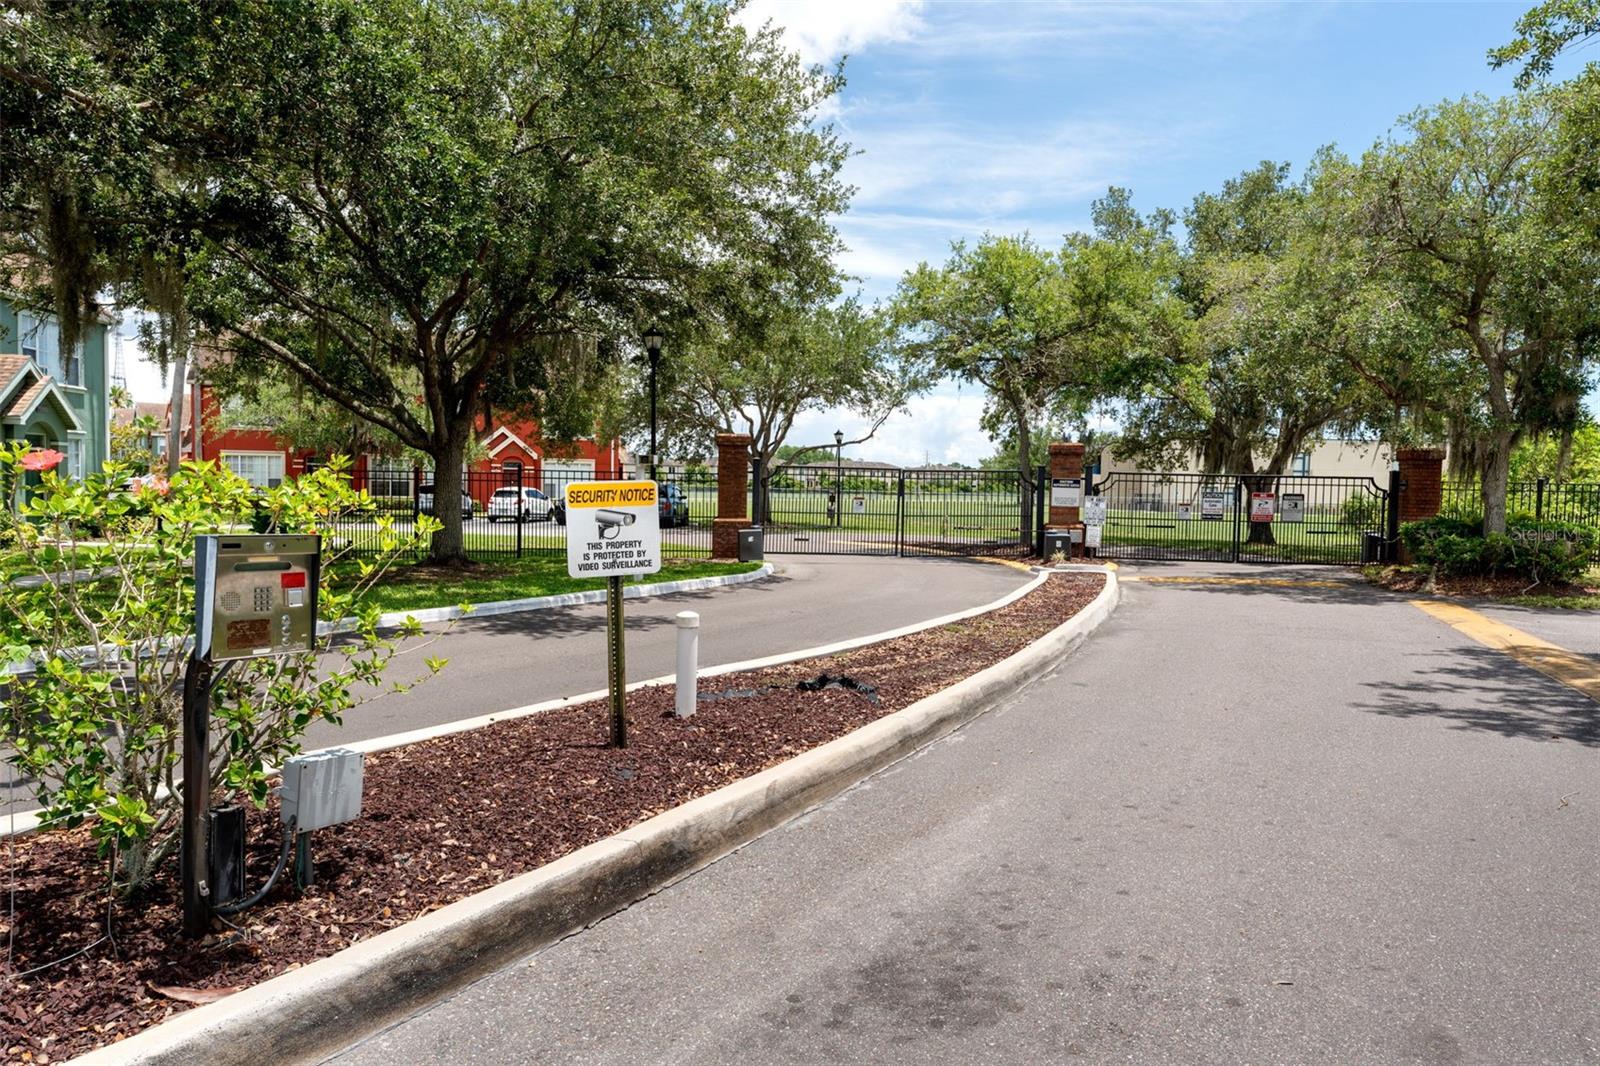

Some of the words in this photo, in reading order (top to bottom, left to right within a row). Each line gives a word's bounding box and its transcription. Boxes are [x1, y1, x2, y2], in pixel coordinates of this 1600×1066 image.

[568, 489, 618, 503] SECURITY
[619, 488, 655, 501] NOTICE
[586, 542, 603, 550] THIS
[606, 540, 642, 549] PROPERTY
[583, 553, 590, 561] IS
[593, 551, 634, 560] PROTECTED
[578, 562, 599, 571] VIDEO
[602, 559, 653, 570] SURVEILLANCE
